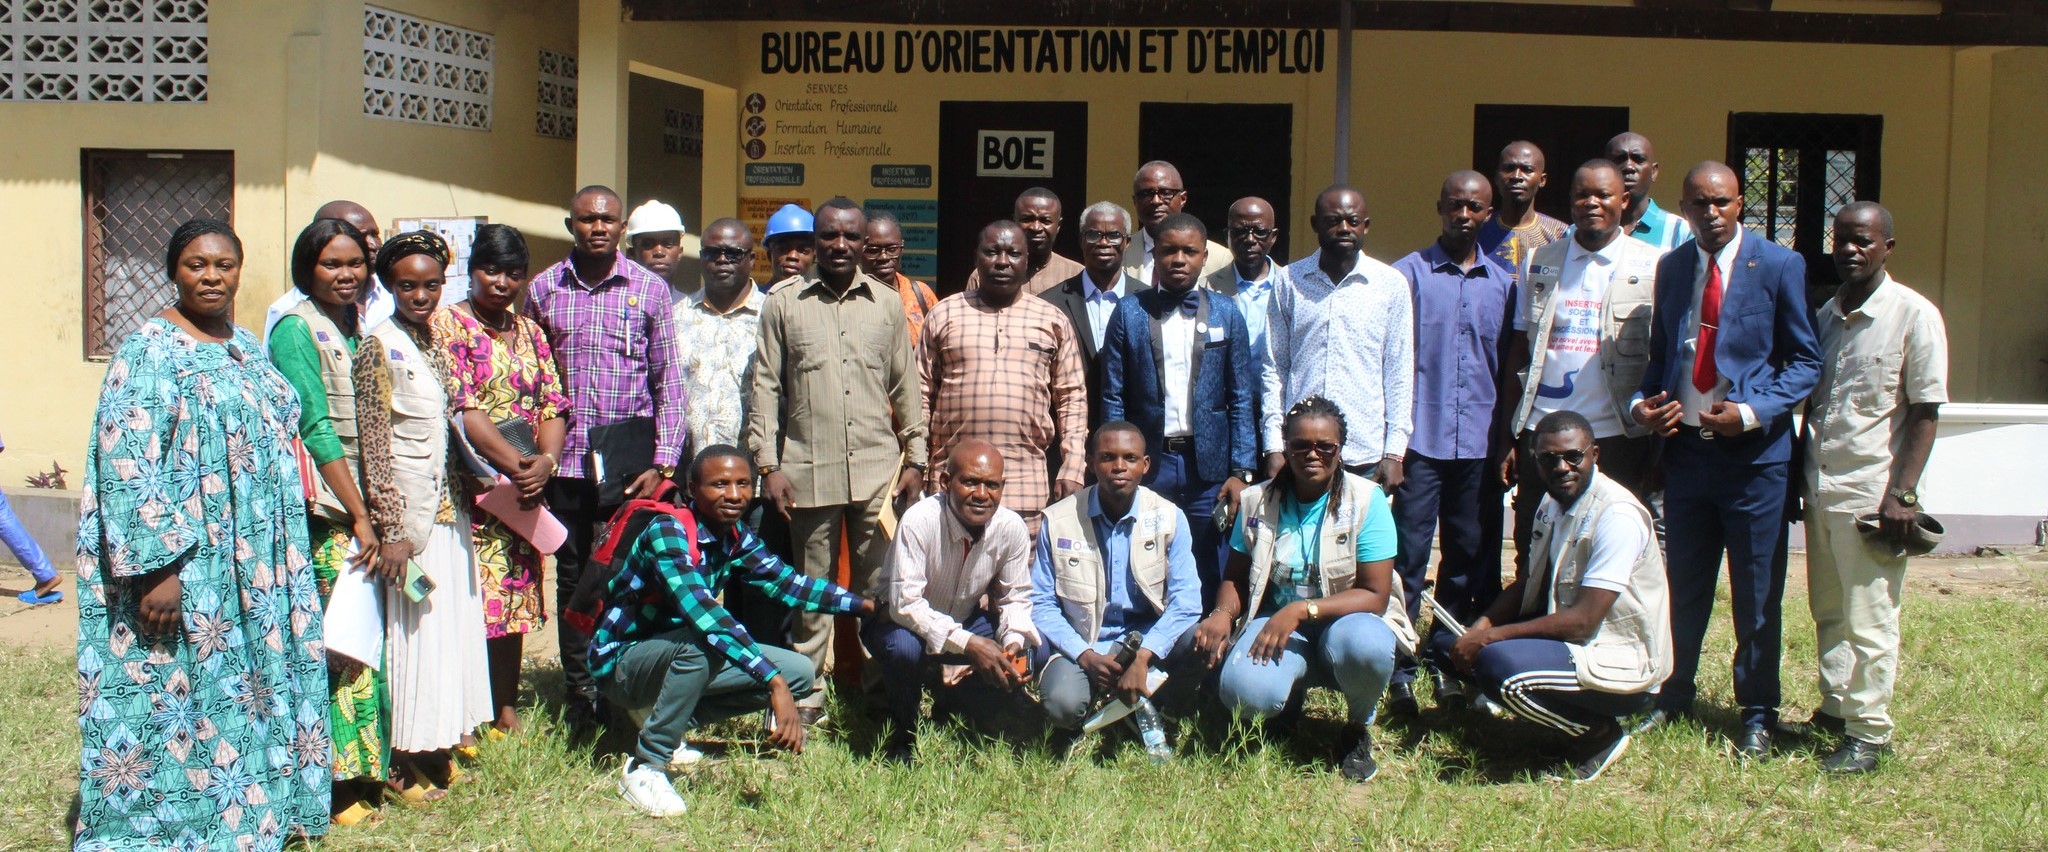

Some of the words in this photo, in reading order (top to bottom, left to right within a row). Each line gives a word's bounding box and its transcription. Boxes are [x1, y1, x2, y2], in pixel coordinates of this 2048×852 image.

[761, 31, 884, 74] BUREAU
[895, 29, 1130, 73] D'ORIENTATION
[1138, 29, 1179, 73] ET
[1187, 29, 1325, 73] D'EMPLOI
[806, 83, 849, 94] SERVICES
[775, 99, 823, 112] Orientation
[830, 99, 898, 115] Professionnelle
[775, 120, 827, 135] Formation
[836, 120, 882, 135] Humaine
[773, 139, 816, 156] Insertion
[824, 140, 892, 158] Professionnelle
[984, 136, 1046, 170] BOE
[882, 167, 916, 176] INSERTION
[746, 175, 801, 184] PROFESSIONNELLE
[872, 177, 930, 185] PROFESSIONNELLE
[1565, 300, 1602, 309] INSERTIO
